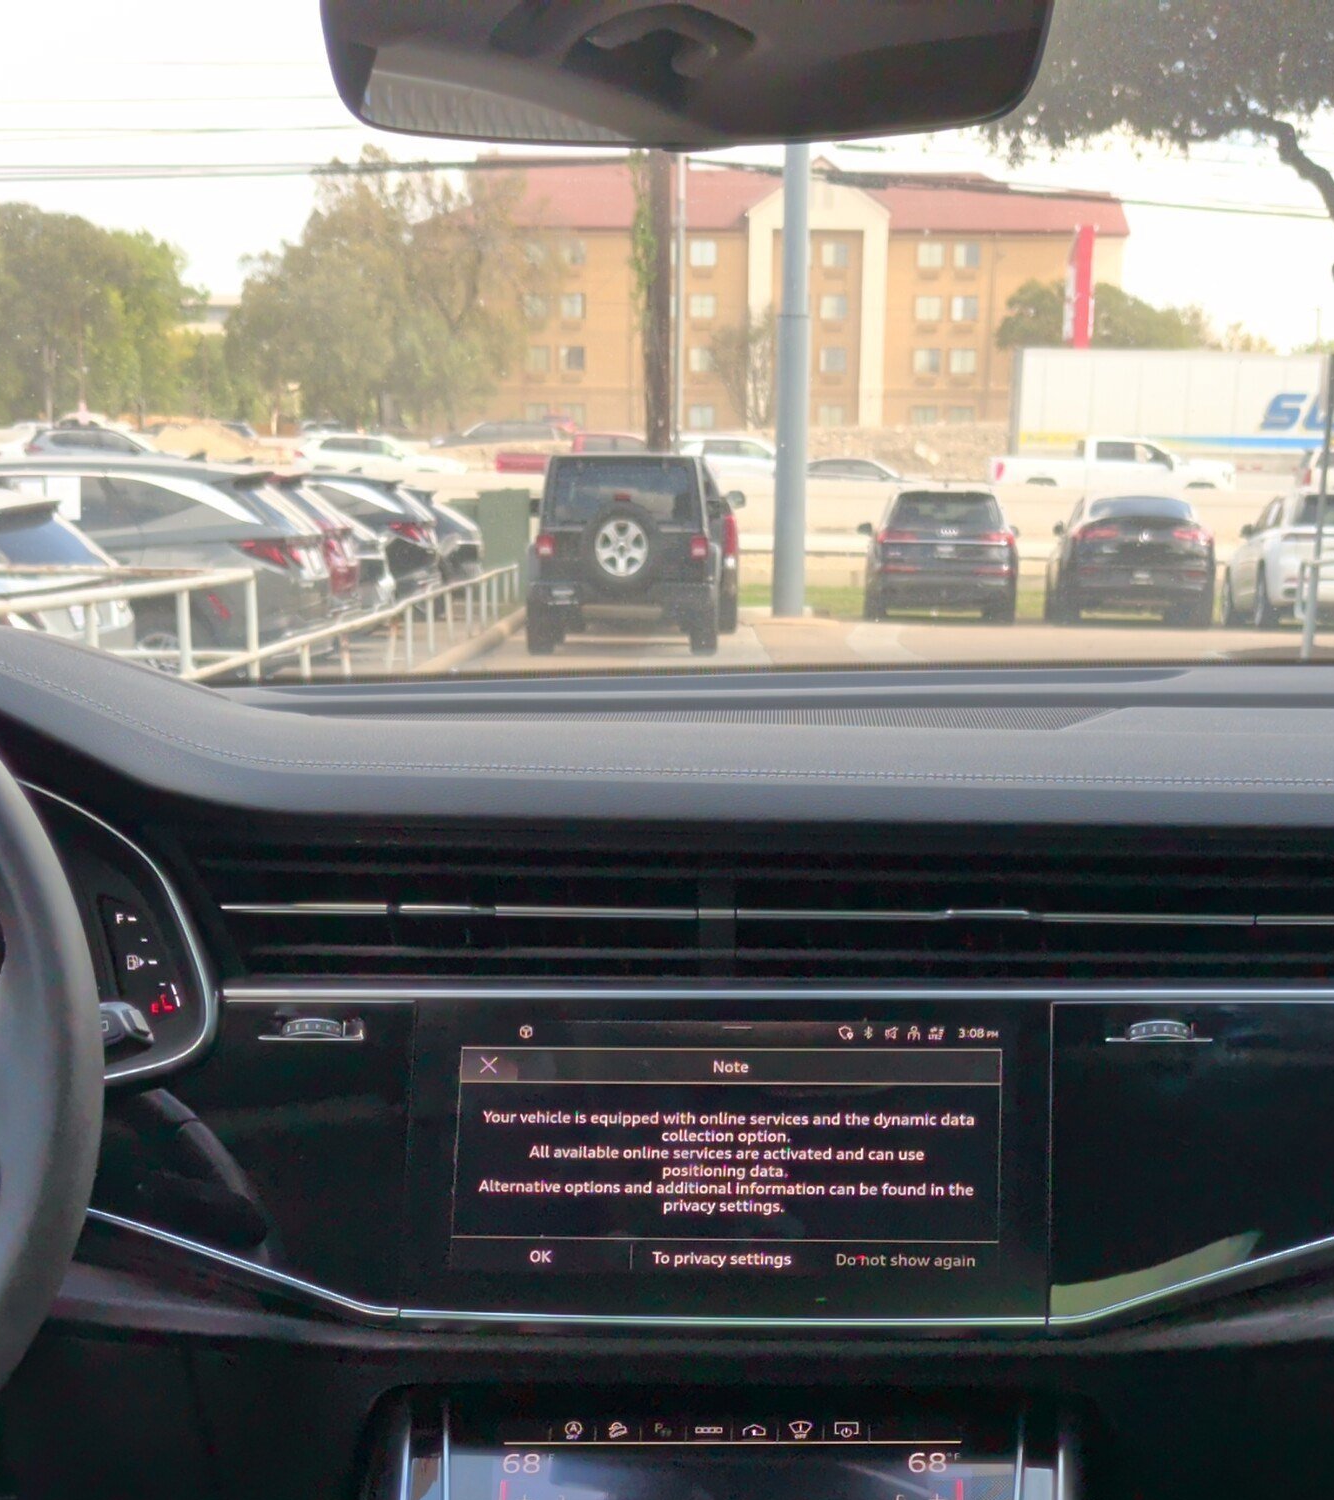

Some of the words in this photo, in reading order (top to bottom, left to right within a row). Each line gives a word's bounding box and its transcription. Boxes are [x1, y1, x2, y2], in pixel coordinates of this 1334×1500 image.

[116, 913, 124, 924] F
[958, 1028, 985, 1039] 3:08
[986, 1031, 999, 1039] PM
[713, 1060, 749, 1074] Note
[483, 1110, 517, 1124] Your
[520, 1110, 571, 1125] vehicle
[575, 1111, 588, 1125] is
[590, 1111, 659, 1128] equipped
[663, 1111, 696, 1125] with
[700, 1112, 746, 1126] online
[750, 1113, 809, 1126] services
[813, 1113, 841, 1126] and
[845, 1113, 870, 1126] the
[873, 1113, 937, 1129] dynamic
[941, 1113, 975, 1127] data
[661, 1129, 734, 1143] collection
[738, 1130, 792, 1146] option.
[529, 1145, 550, 1159] All
[554, 1146, 619, 1160] available
[623, 1146, 669, 1160] online
[673, 1147, 732, 1160] services
[736, 1150, 759, 1160] are
[763, 1147, 832, 1161] activated
[836, 1148, 864, 1161] and
[868, 1150, 894, 1161] can
[898, 1151, 925, 1161] use
[661, 1164, 746, 1180] positioning
[750, 1165, 789, 1179] data.
[478, 1179, 561, 1194] Alternative
[564, 1181, 621, 1197] options
[624, 1181, 652, 1194] and
[656, 1181, 732, 1195] additional
[736, 1182, 825, 1196] information
[829, 1185, 855, 1196] can
[859, 1182, 878, 1196] be
[881, 1183, 926, 1196] found
[931, 1183, 944, 1197] in
[948, 1183, 974, 1197] the
[663, 1200, 716, 1215] privacy
[719, 1200, 786, 1216] settings.
[530, 1250, 552, 1263] OK
[652, 1251, 670, 1265] To
[674, 1252, 726, 1267] privacy
[730, 1253, 792, 1268] settings
[836, 1253, 857, 1267] Do
[860, 1254, 886, 1267] not
[890, 1254, 930, 1267] show
[934, 1254, 976, 1270] again
[503, 1453, 541, 1474] 68
[908, 1452, 947, 1473] 68
